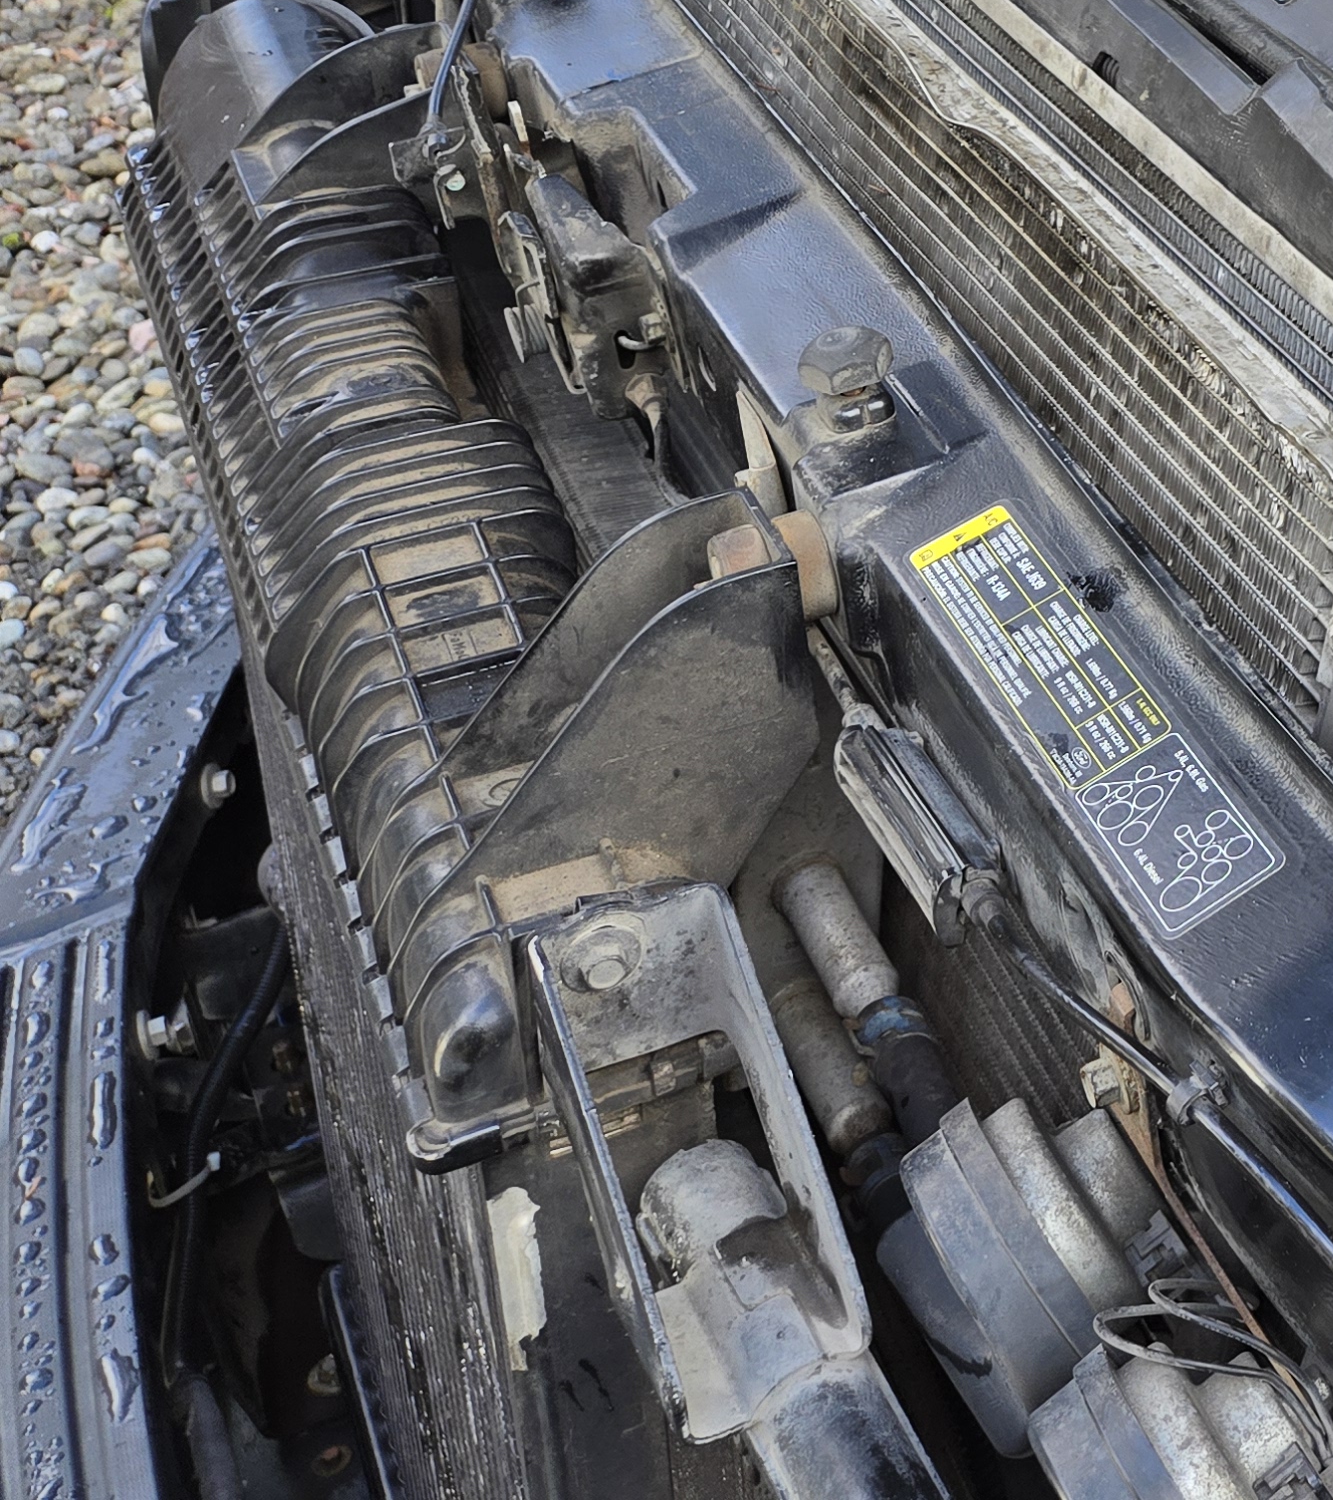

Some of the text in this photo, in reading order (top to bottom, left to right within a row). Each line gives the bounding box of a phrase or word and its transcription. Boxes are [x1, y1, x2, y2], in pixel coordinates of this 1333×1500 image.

[984, 573, 1012, 601] R-134A
[1014, 556, 1047, 591] SAE J639
[1072, 748, 1090, 766] Ford
[1171, 748, 1192, 767] 5.4L,
[1193, 775, 1212, 793] Gas
[1132, 847, 1165, 886] 6.4L Diesel
